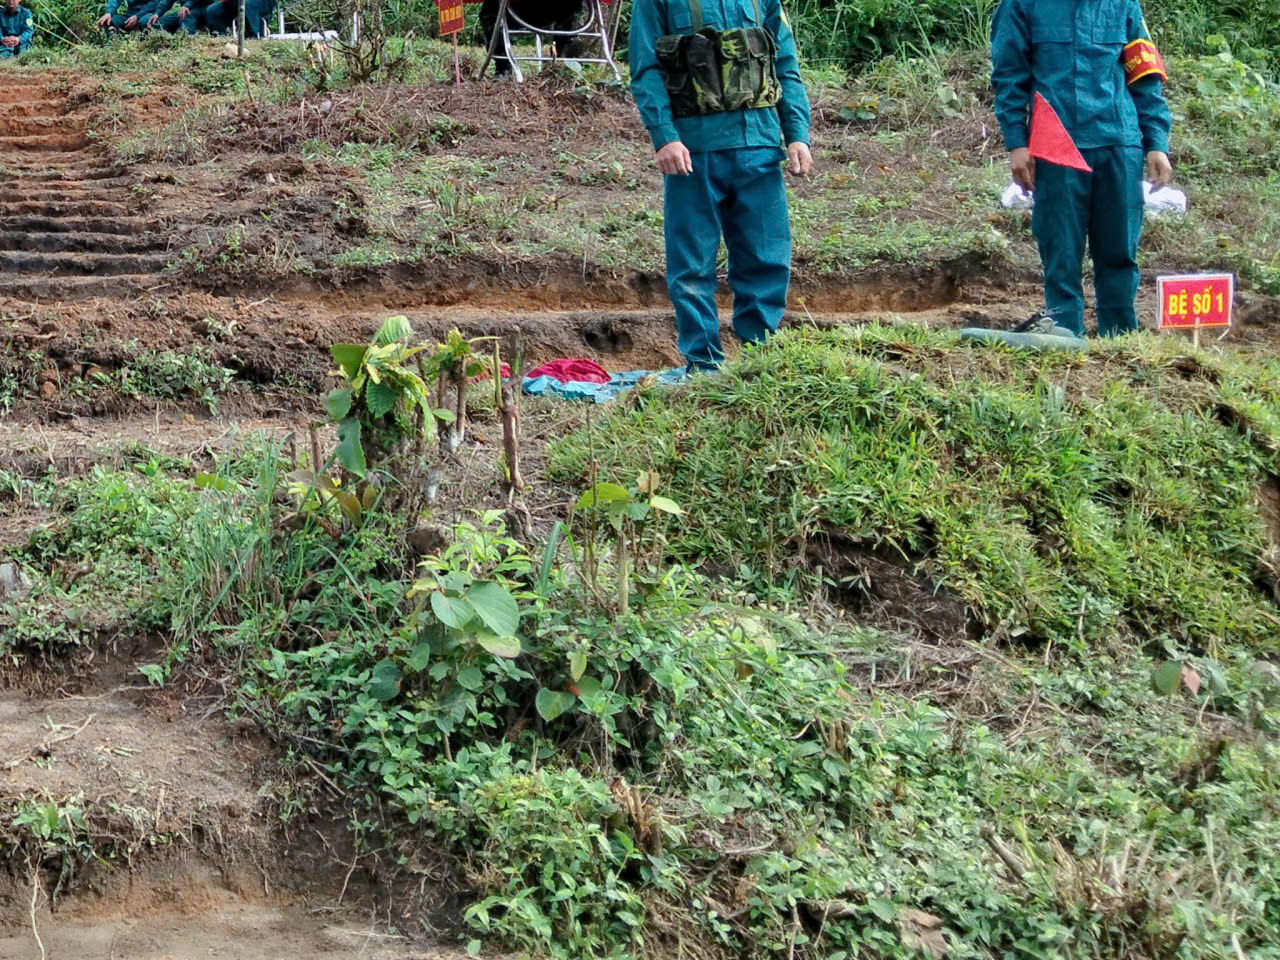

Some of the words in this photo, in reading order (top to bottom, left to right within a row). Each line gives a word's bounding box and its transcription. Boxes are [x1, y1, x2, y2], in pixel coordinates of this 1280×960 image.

[1169, 288, 1187, 319] BỆ
[1192, 285, 1212, 314] SỐ
[1216, 292, 1223, 313] 1
